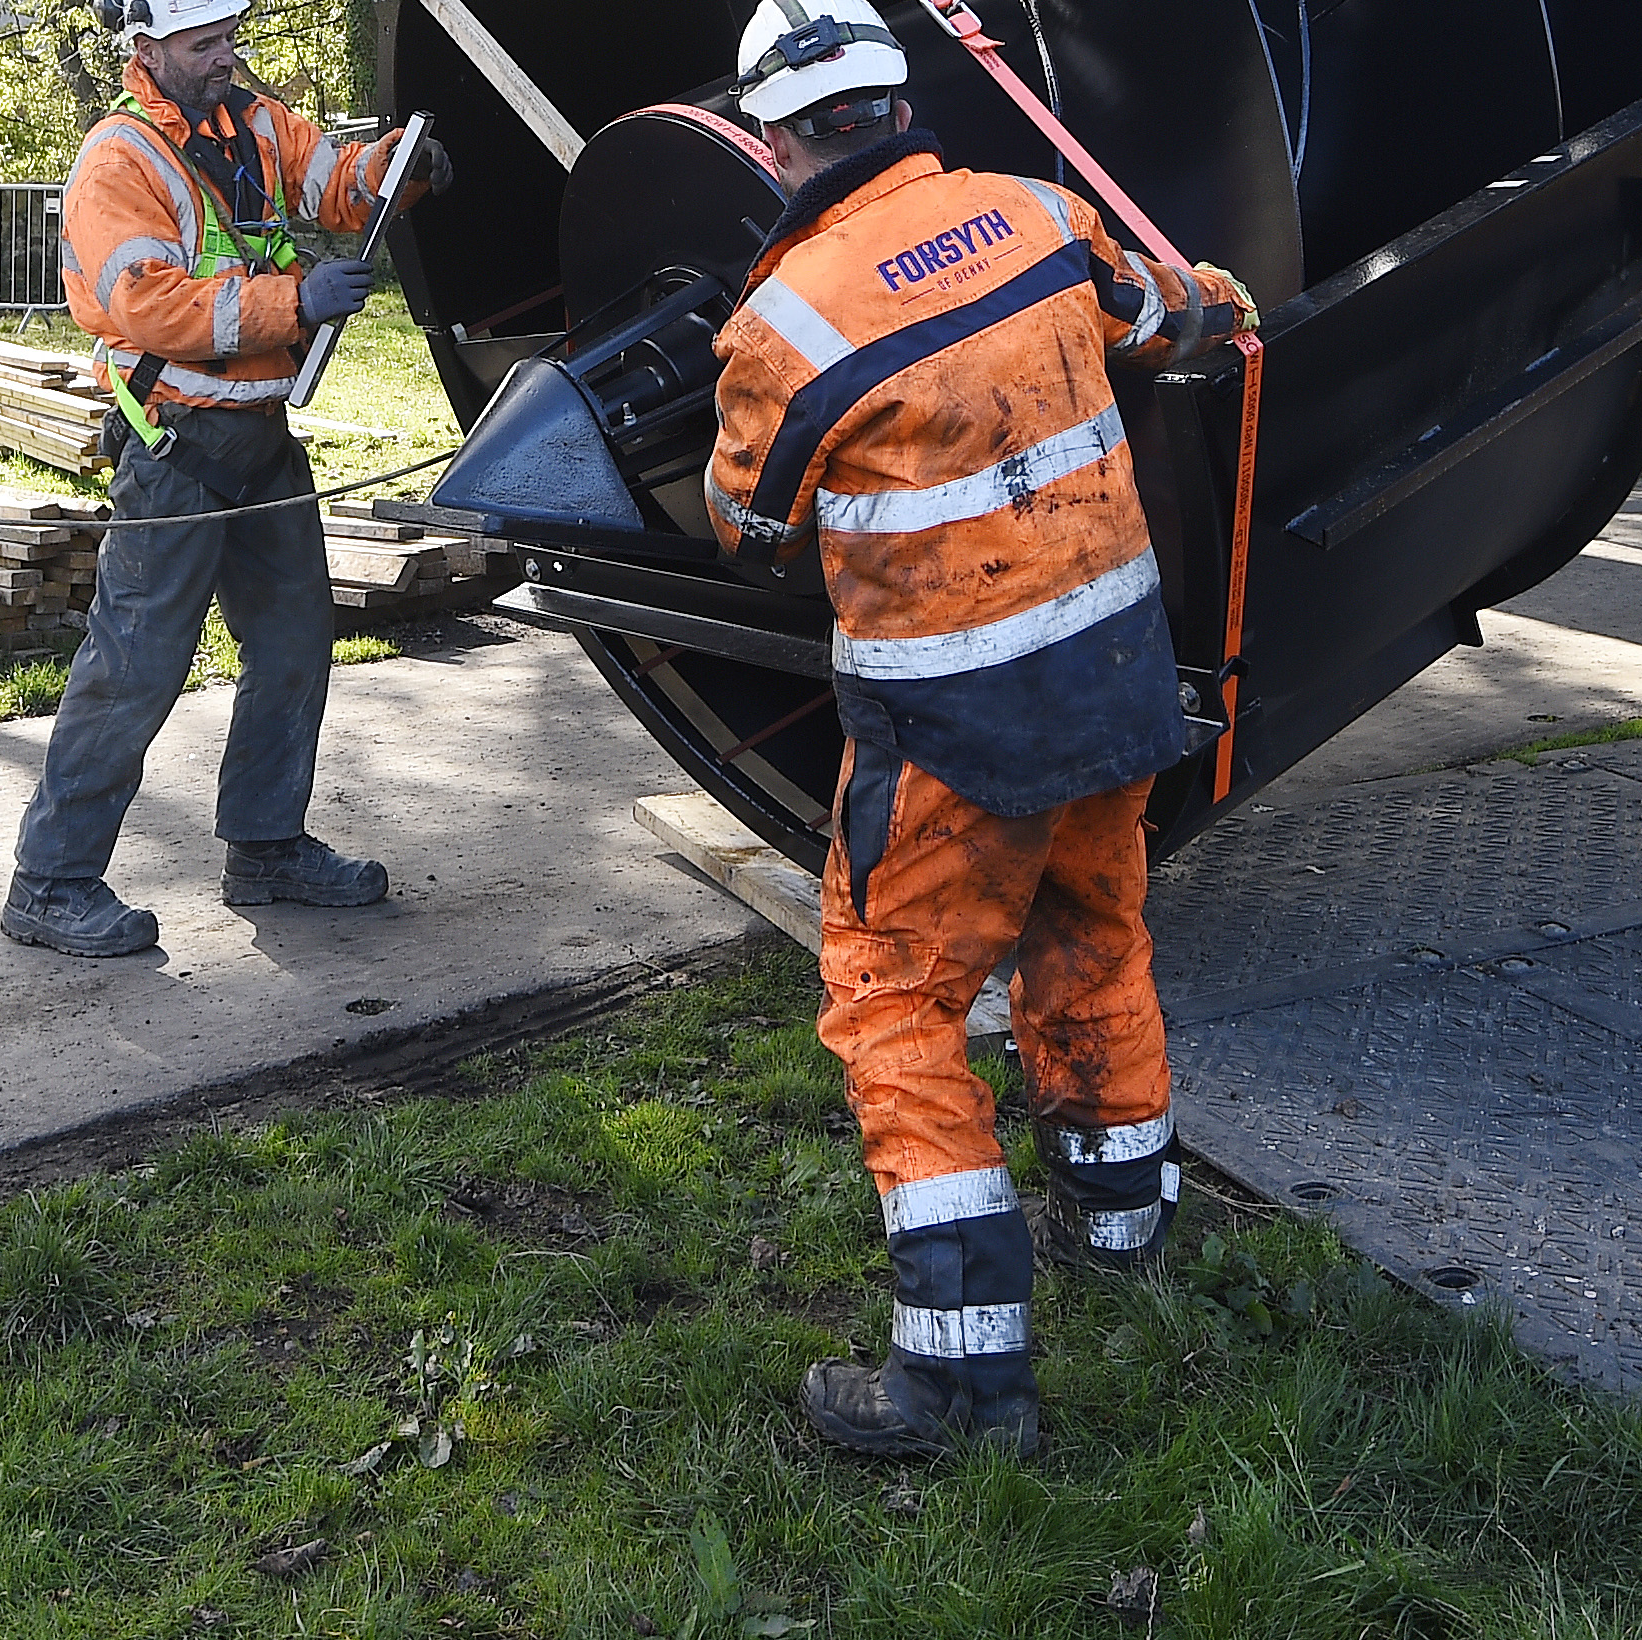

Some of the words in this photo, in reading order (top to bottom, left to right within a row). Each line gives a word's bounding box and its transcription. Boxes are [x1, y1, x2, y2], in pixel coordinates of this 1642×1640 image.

[739, 137, 763, 155] 5000
[875, 209, 1014, 292] FORSYTH
[937, 276, 951, 290] OF
[954, 257, 991, 284] DENNY
